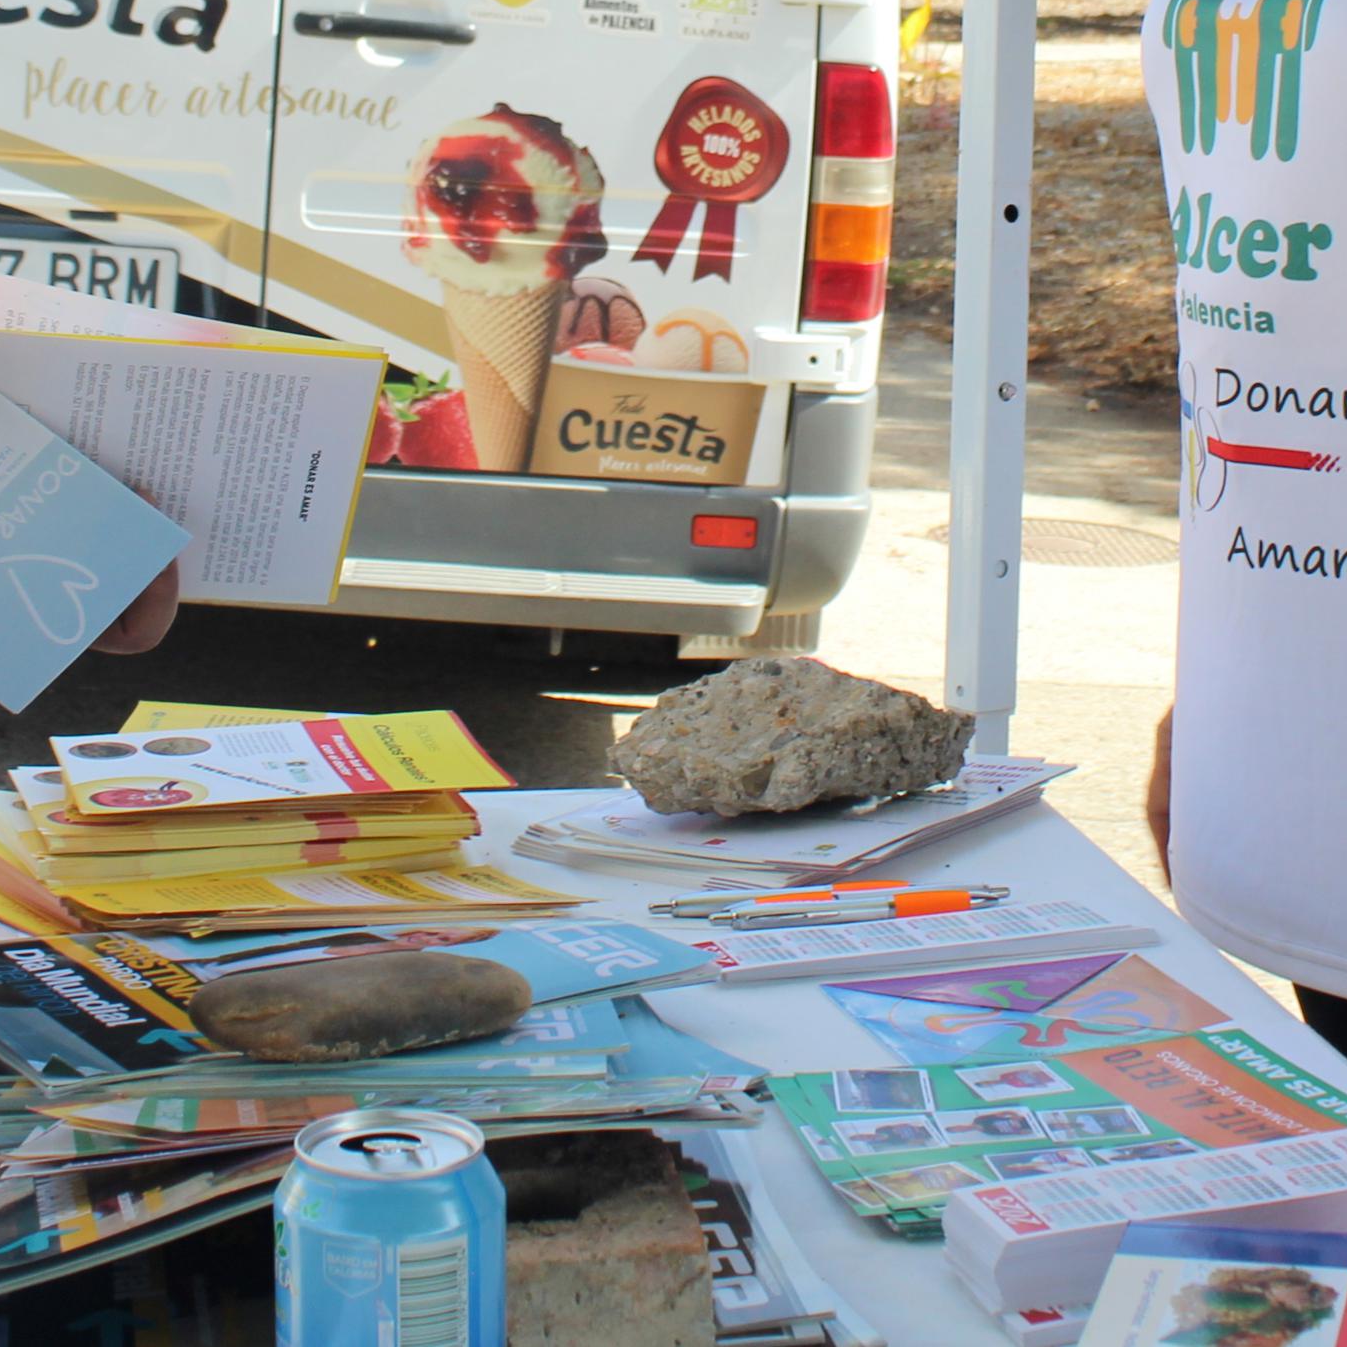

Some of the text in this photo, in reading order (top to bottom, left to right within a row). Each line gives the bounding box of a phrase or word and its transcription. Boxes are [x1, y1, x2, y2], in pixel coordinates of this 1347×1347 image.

[601, 15, 656, 32] PALENCIA
[23, 57, 402, 132] placer artesanal
[680, 145, 761, 187] ARTESANOS
[702, 133, 741, 158] 100%
[1171, 183, 1334, 282] Alcer
[559, 408, 727, 464] Cuesta
[298, 448, 321, 521] "DONAR ES AMAR"
[89, 956, 153, 990] PARDO
[532, 924, 659, 978] CER
[3, 948, 148, 1027] Día Mundial
[1104, 1049, 1186, 1089] RETO
[1285, 1079, 1327, 1098] ES
